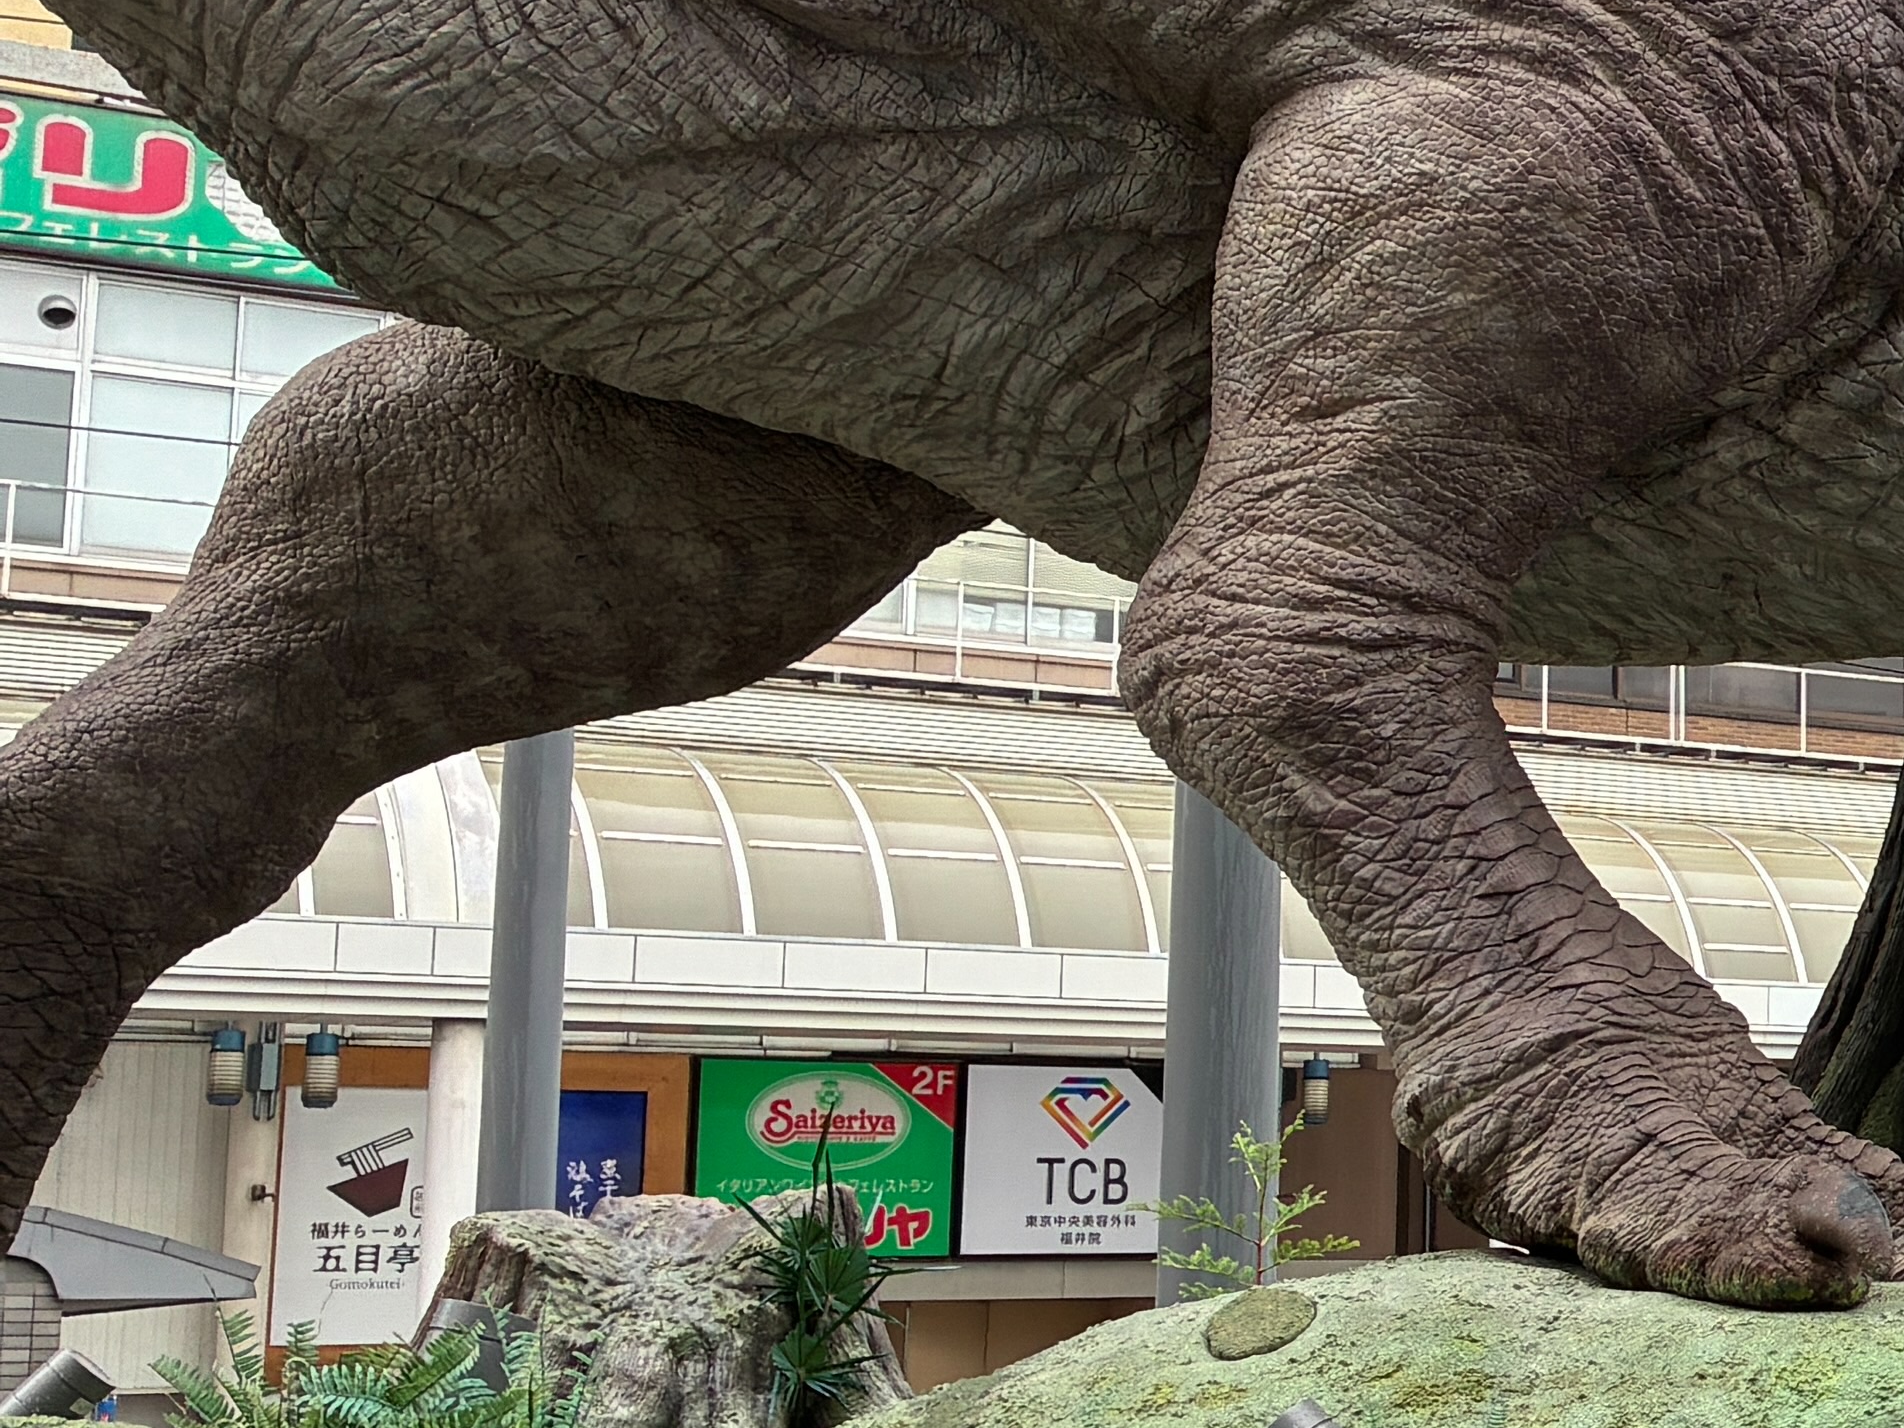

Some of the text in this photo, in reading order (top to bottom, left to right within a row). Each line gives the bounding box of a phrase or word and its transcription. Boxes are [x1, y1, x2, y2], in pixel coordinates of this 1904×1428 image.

[912, 1065, 954, 1095] 2F
[1036, 1157, 1129, 1206] TCB
[1025, 1215, 1137, 1229] 東京中央美容外科
[1060, 1232, 1102, 1246] 福井院
[312, 1242, 420, 1274] 五目亭
